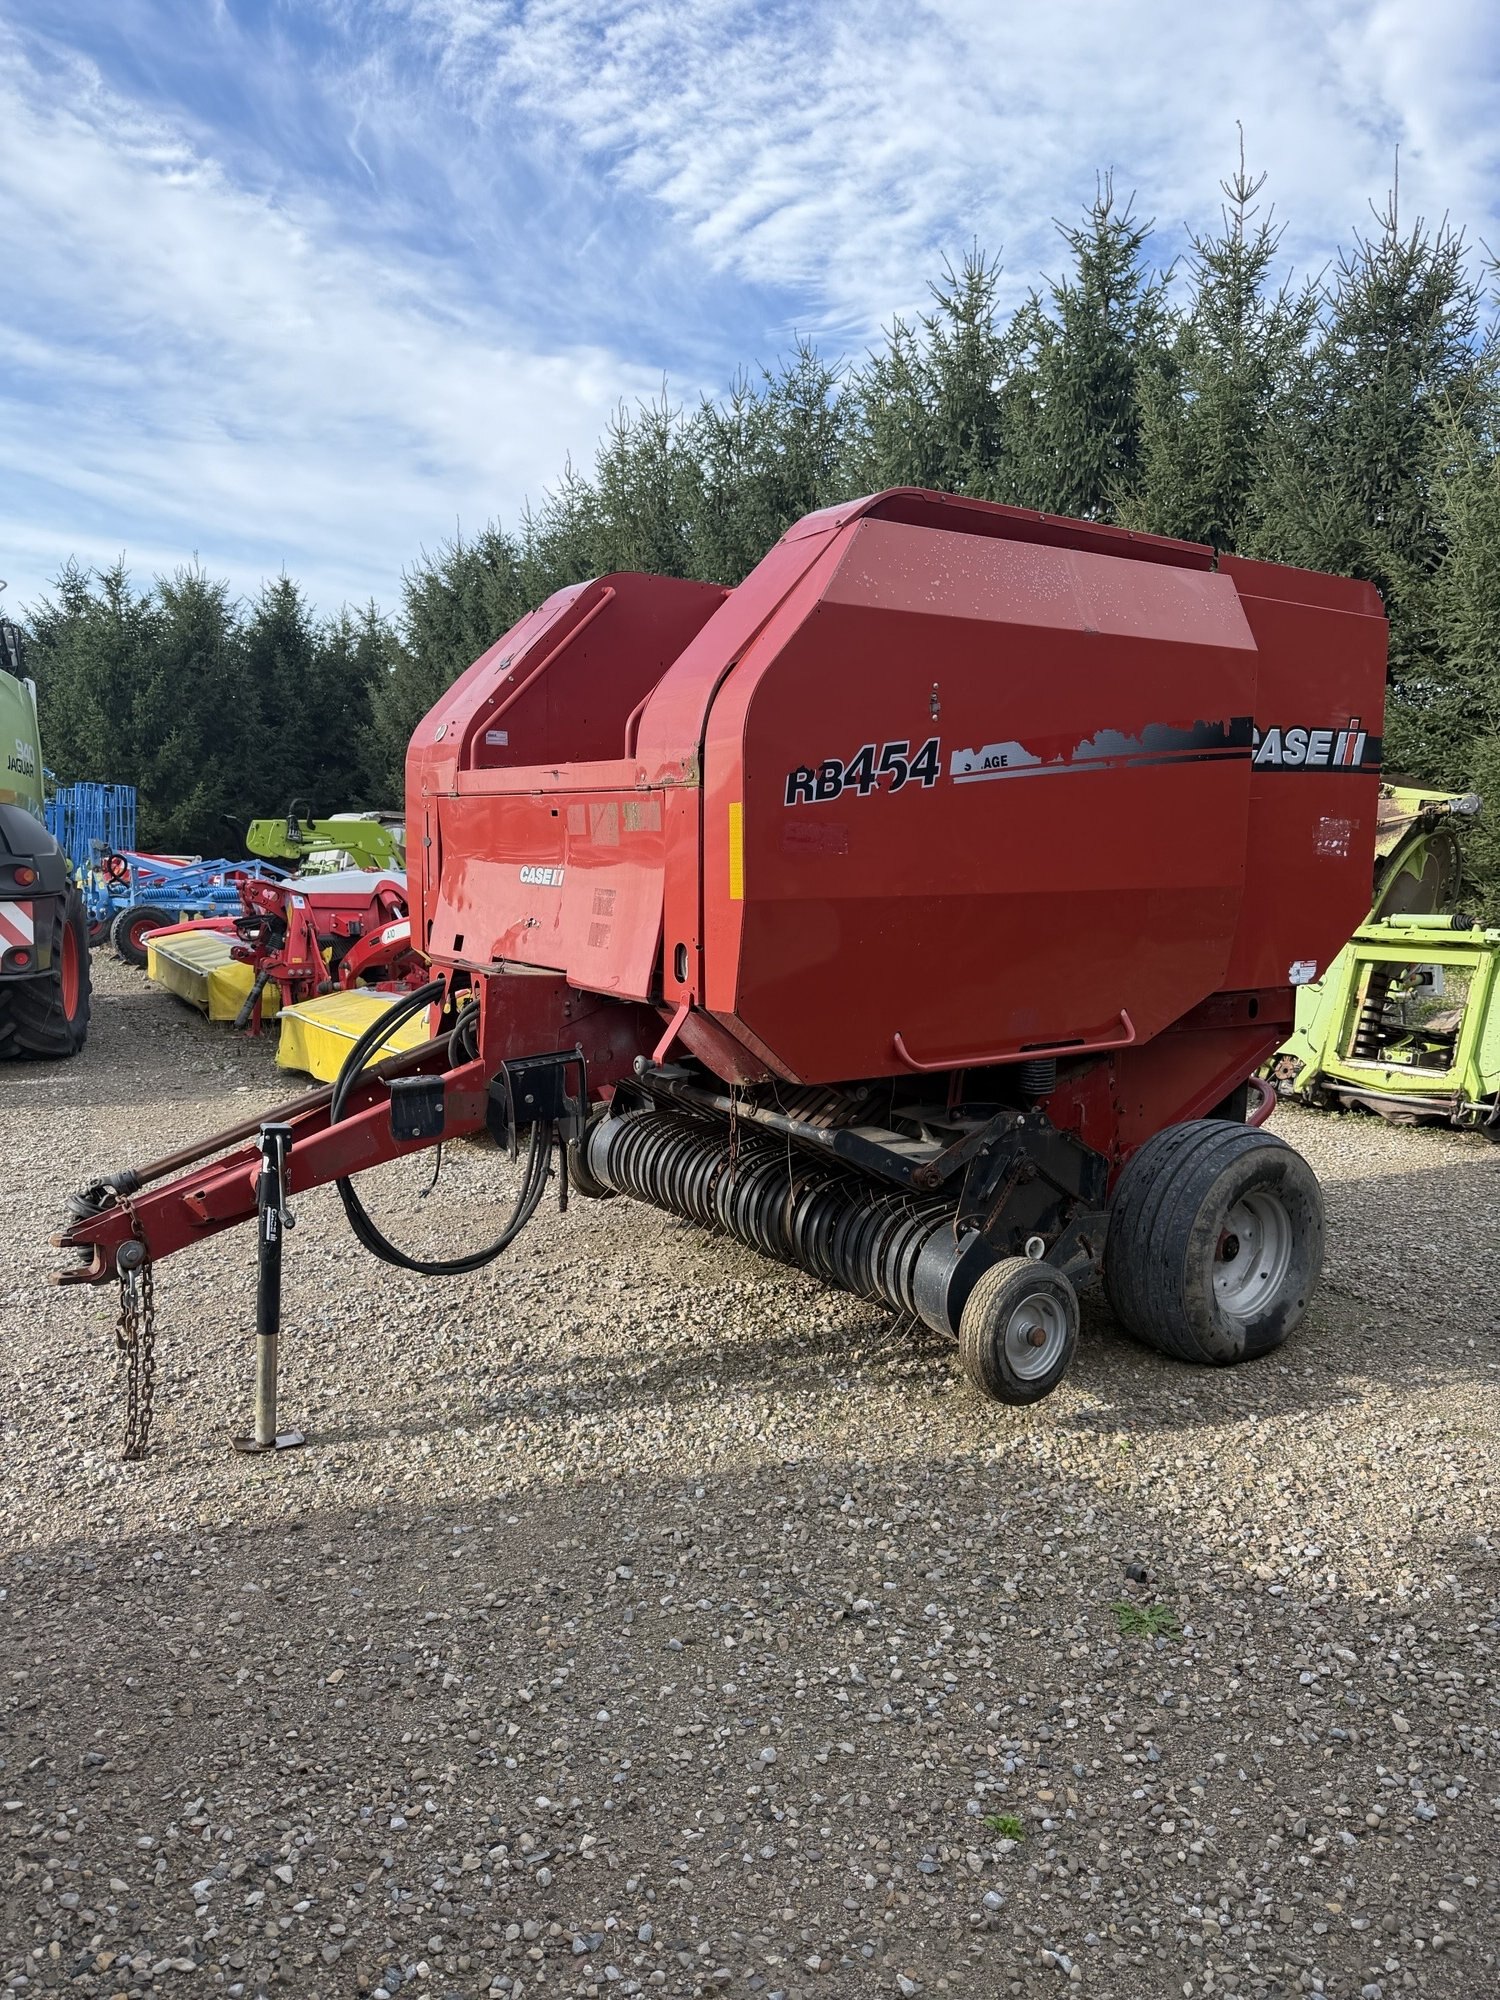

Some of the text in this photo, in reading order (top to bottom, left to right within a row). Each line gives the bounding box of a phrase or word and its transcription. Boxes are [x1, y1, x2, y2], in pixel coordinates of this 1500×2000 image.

[15, 738, 35, 763] 940
[8, 754, 34, 778] JAGUAR
[784, 737, 942, 807] RB454
[520, 865, 553, 886] CASE
